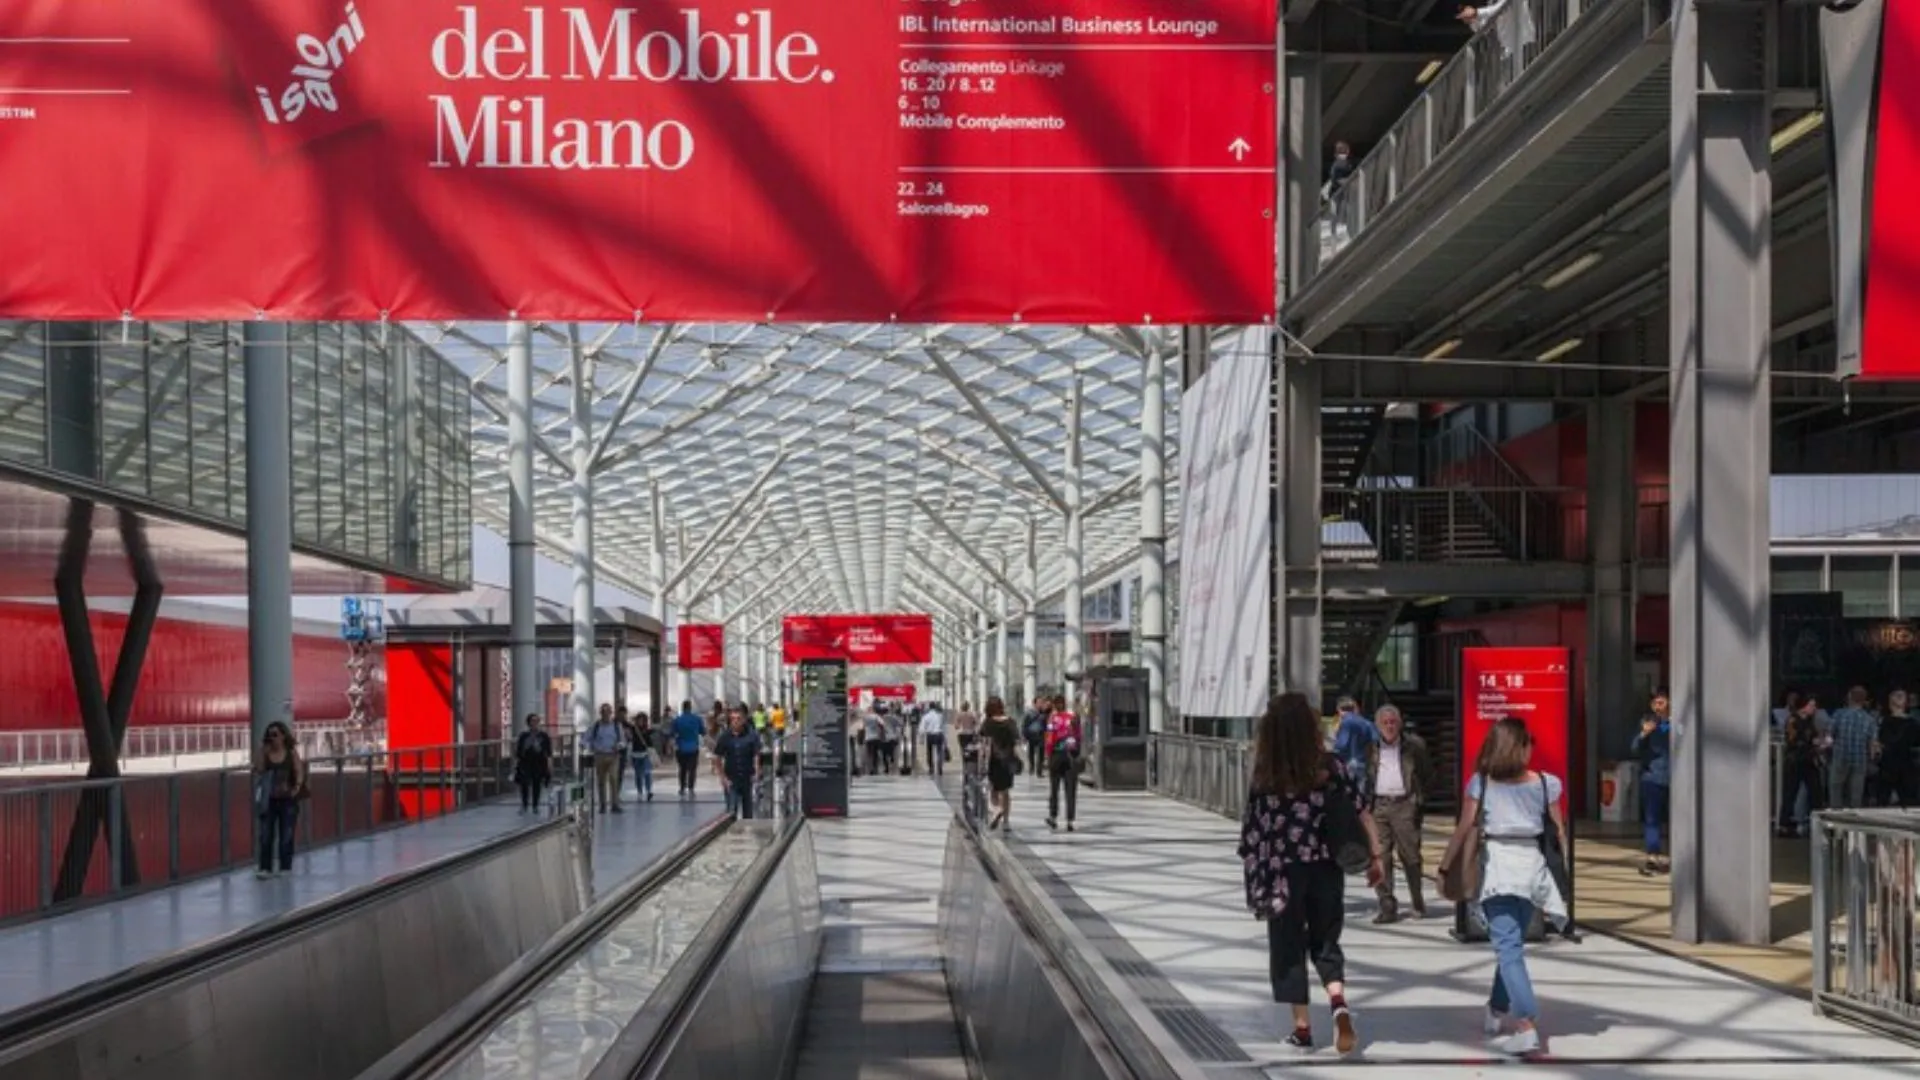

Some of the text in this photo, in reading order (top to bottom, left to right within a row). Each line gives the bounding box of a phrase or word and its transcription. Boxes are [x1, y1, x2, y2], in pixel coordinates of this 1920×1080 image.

[899, 15, 1219, 38] IBL International Business Lounge
[431, 6, 835, 83] del Mobile.
[899, 59, 1065, 77] Collegamento Linkage
[900, 113, 1066, 131] Mobile Complemento
[428, 94, 694, 171] Milano
[898, 200, 989, 218] SaloneBagno
